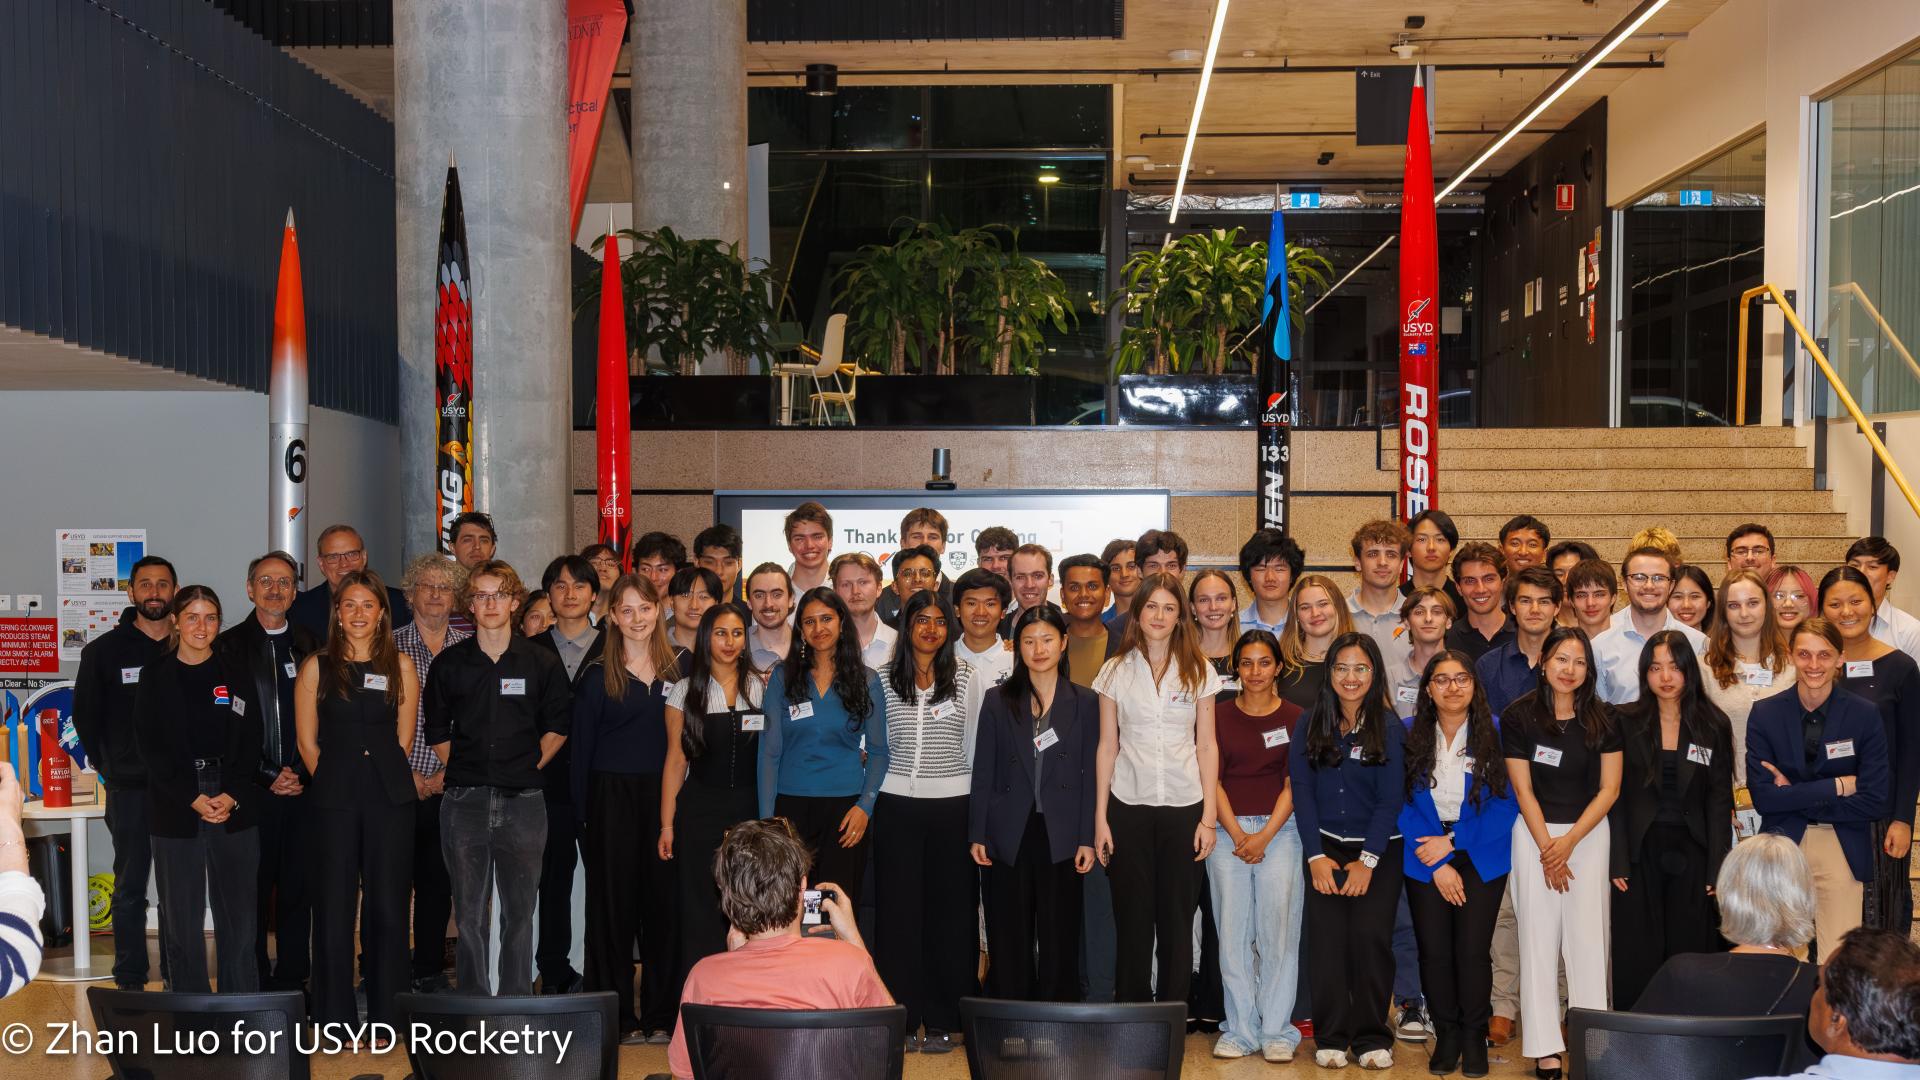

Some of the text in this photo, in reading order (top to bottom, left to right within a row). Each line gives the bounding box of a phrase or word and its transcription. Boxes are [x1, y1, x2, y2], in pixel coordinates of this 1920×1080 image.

[568, 21, 603, 40] YDNEY
[1403, 323, 1433, 332] USYD
[1262, 414, 1290, 422] USYD
[1262, 446, 1289, 462] 133
[1406, 383, 1430, 519] ROSE
[285, 439, 306, 483] 6
[442, 469, 462, 561] ING
[844, 529, 1036, 544] Thank or Cng
